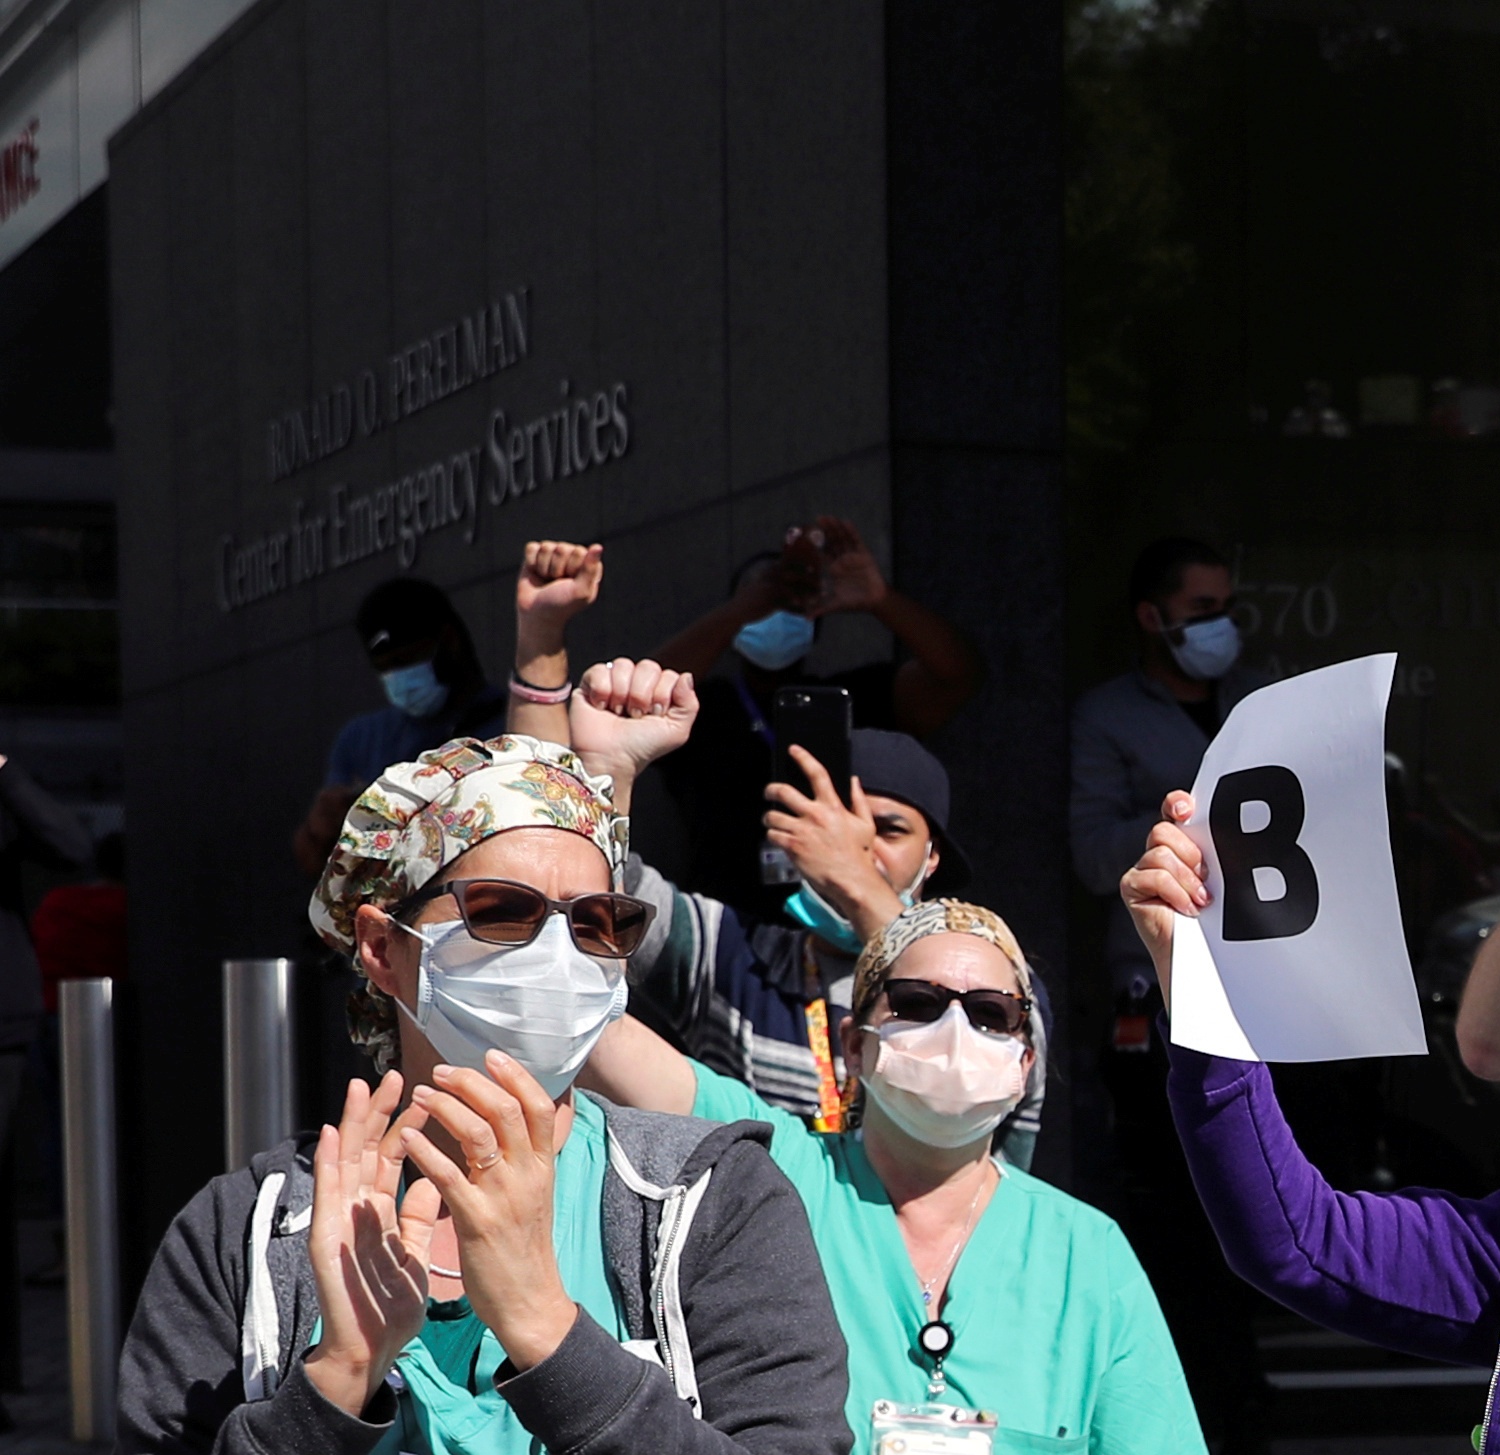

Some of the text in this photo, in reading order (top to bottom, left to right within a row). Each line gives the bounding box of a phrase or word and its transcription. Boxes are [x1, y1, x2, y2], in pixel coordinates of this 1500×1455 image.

[268, 286, 531, 484] RONALD O. PERELMAN
[218, 378, 630, 613] Center for Emergency Services
[1209, 765, 1318, 941] B
